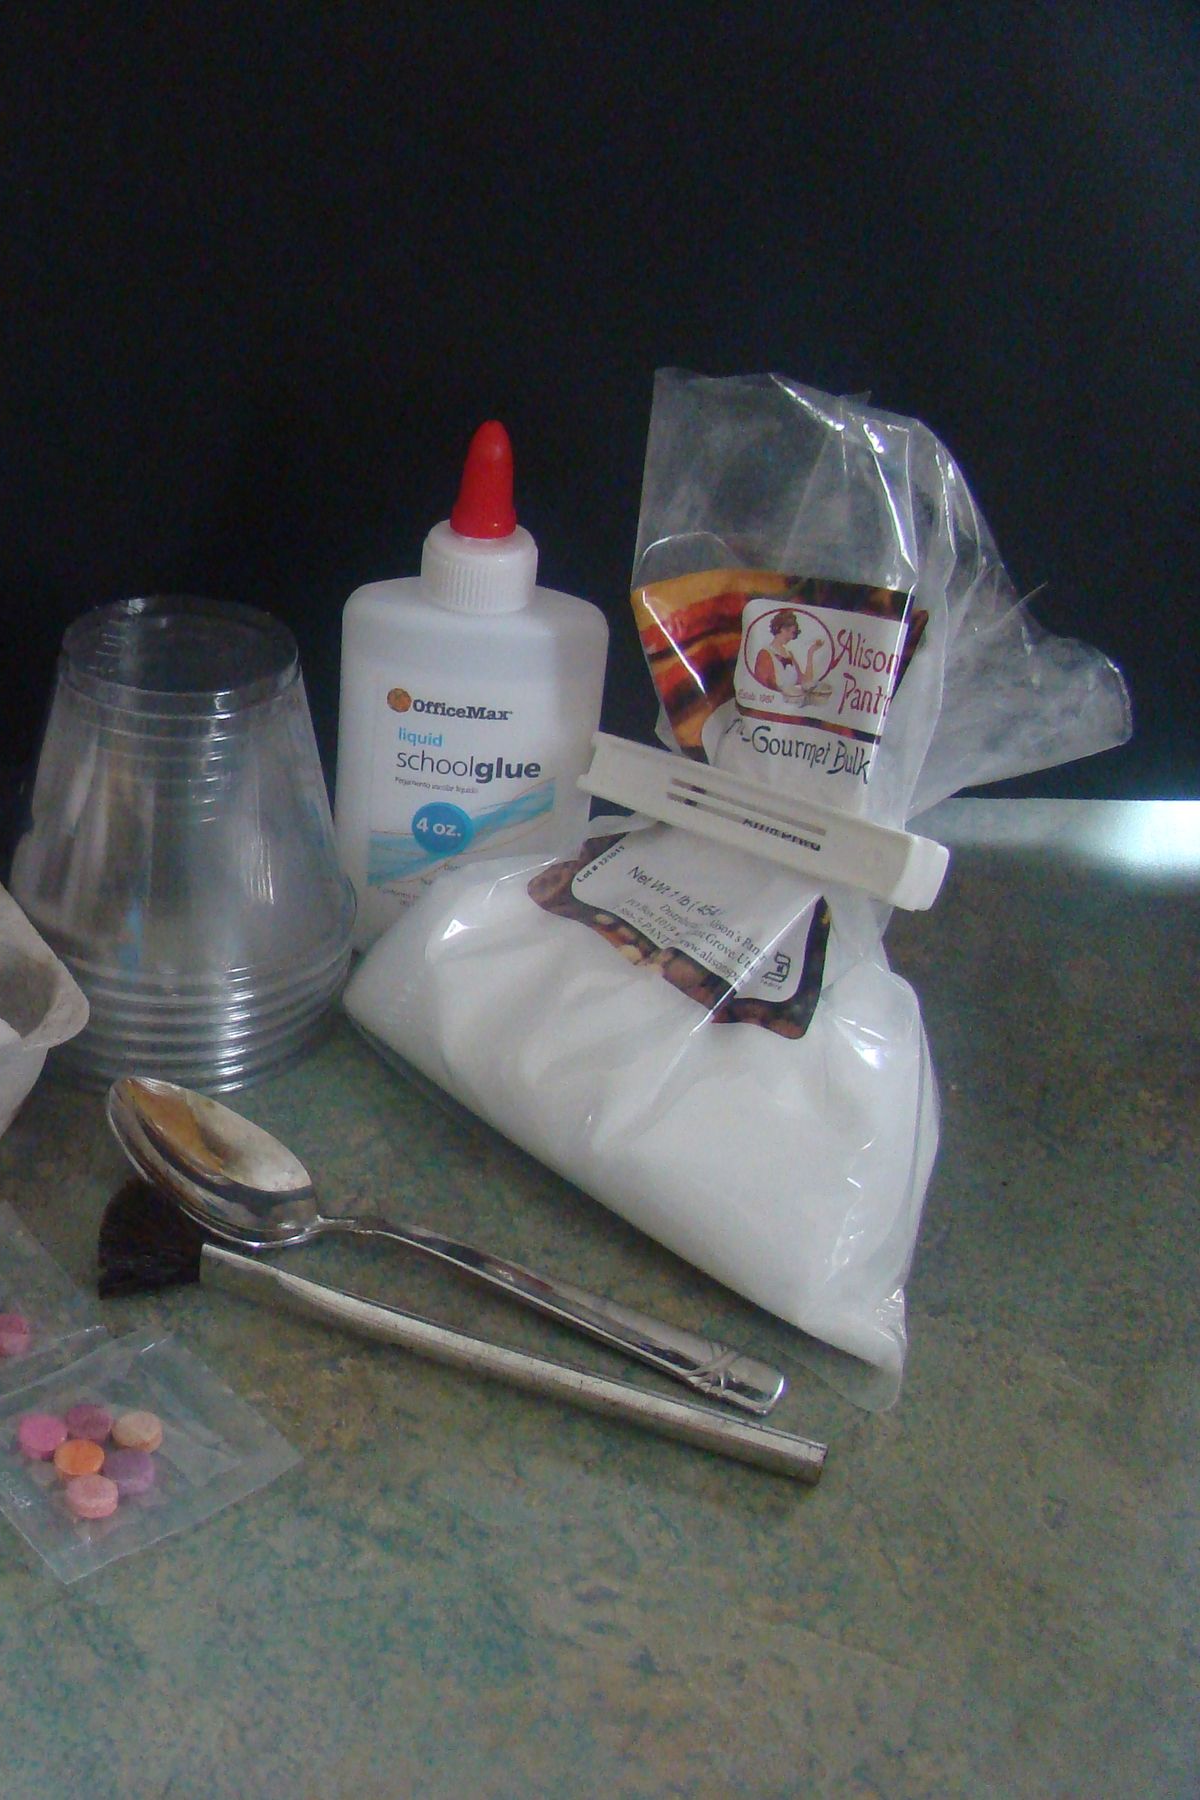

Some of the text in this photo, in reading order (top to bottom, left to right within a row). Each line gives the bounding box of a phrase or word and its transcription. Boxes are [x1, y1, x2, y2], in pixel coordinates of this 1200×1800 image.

[412, 698, 511, 721] OfficeMax
[398, 727, 444, 748] liquid
[827, 739, 871, 785] Bulk
[416, 817, 462, 837] 4 oz.
[575, 868, 593, 883] Lot
[627, 865, 652, 886] Net
[650, 879, 671, 898] Wt
[676, 890, 691, 906] lb
